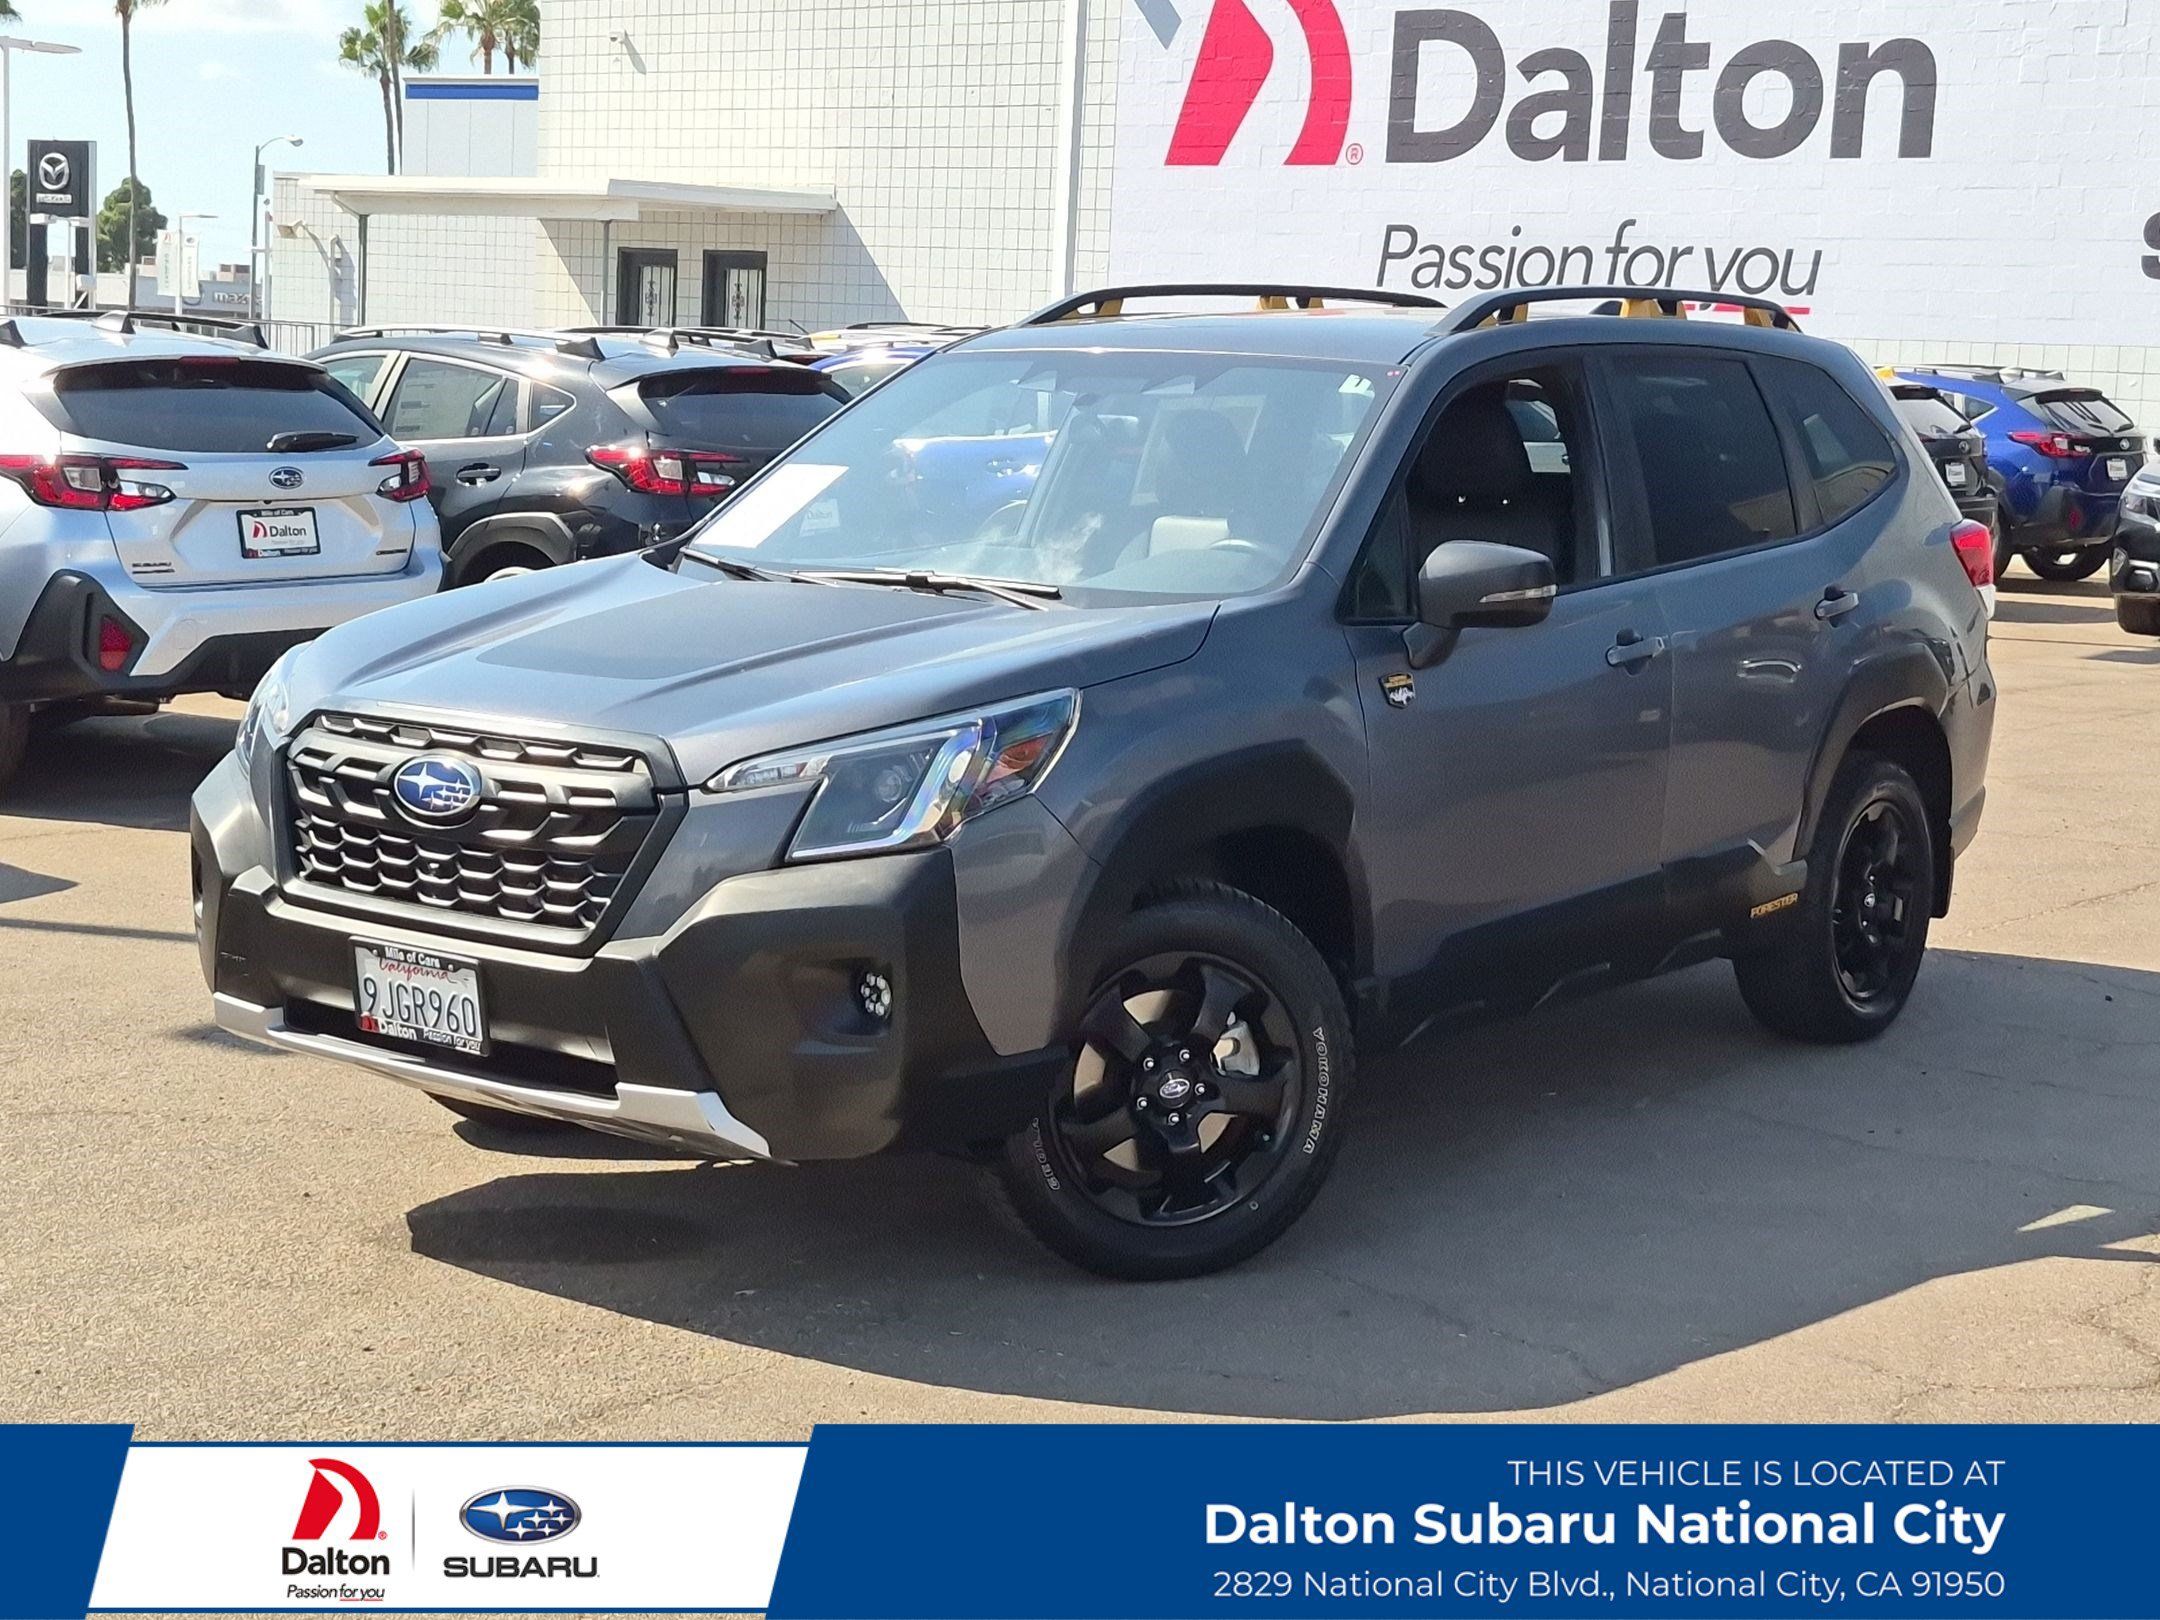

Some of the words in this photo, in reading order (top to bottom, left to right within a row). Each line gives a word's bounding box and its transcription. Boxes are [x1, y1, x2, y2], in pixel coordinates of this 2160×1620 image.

[1387, 0, 1936, 163] Dalton
[1376, 224, 1594, 290] Passion
[1605, 219, 1694, 288] for
[1700, 247, 1823, 303] you
[269, 525, 307, 537] Dalton
[1750, 893, 1798, 919] FORESTER
[379, 956, 456, 982] California
[385, 946, 404, 961] Mile
[406, 951, 416, 963] of
[418, 953, 441, 968] Cars
[363, 977, 477, 1036] 9JGR960
[379, 1020, 418, 1040] Dalton
[1303, 1026, 1330, 1154] YOKOHAMA
